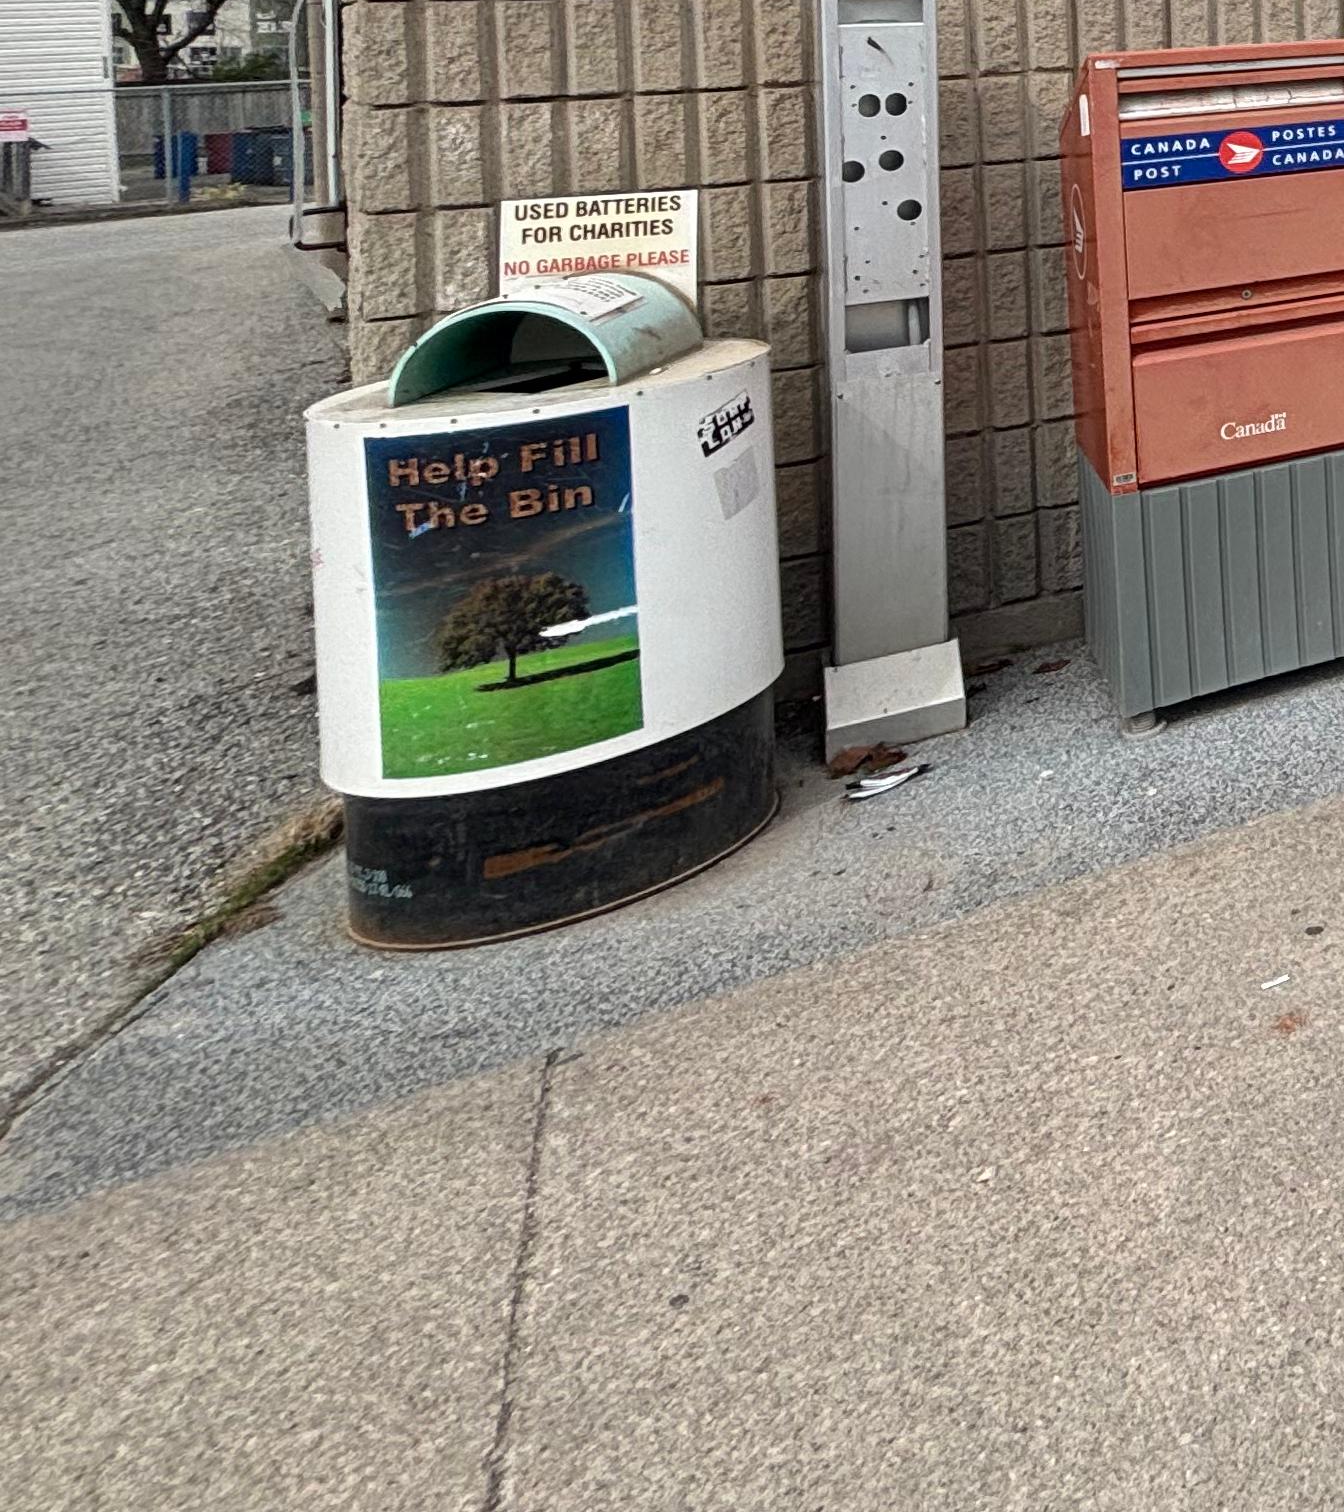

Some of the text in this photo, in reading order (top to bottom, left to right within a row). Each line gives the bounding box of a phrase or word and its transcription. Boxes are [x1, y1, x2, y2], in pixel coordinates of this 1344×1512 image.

[1131, 137, 1212, 156] CANADA
[1271, 124, 1336, 143] POSTES
[1133, 164, 1182, 181] POST
[514, 195, 682, 222] USED BATTERIES
[521, 218, 674, 245] FOR CHARITIES
[503, 249, 691, 276] NO GARBAGE PLEASE
[1220, 412, 1287, 440] Canada
[388, 433, 599, 488] Help Fill
[395, 483, 593, 535] The Bin
